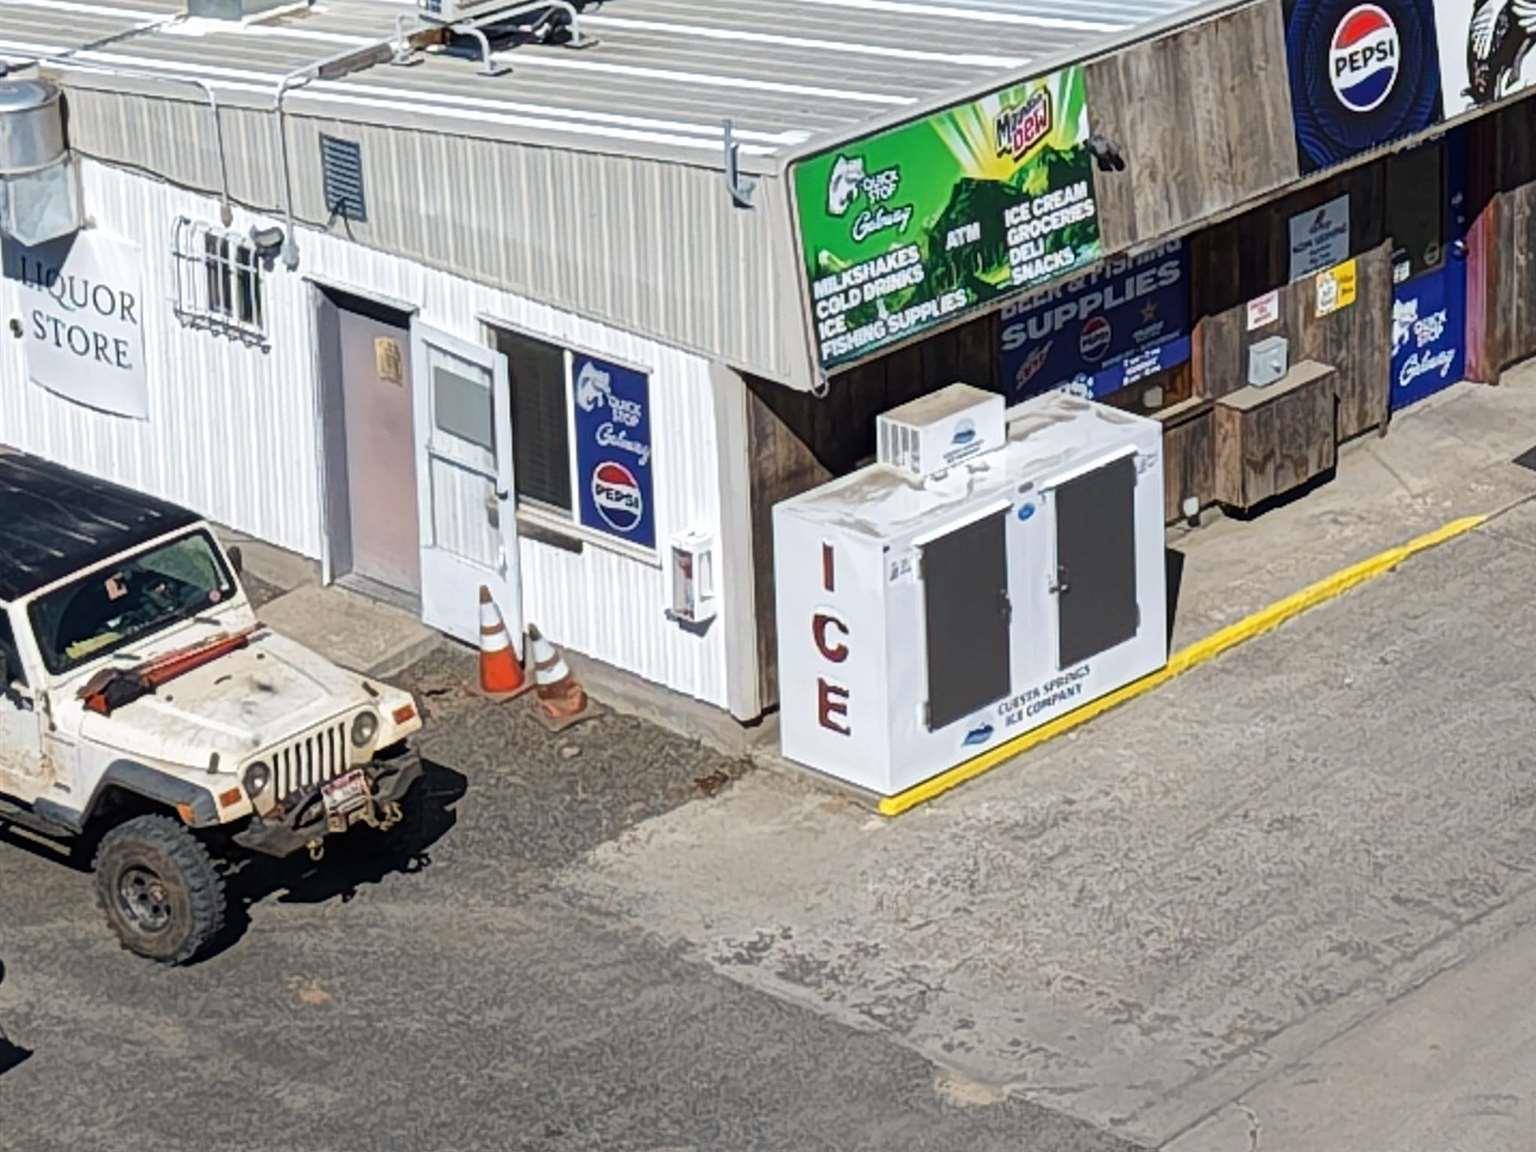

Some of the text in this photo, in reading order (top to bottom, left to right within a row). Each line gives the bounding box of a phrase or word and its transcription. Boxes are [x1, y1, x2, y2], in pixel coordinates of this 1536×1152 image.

[1334, 38, 1395, 78] PEPSI
[1005, 181, 1088, 227] ICE CREAM
[1007, 198, 1094, 246] GROCERIES
[945, 222, 981, 251] ATM
[1009, 237, 1044, 266] DELI
[814, 245, 920, 298] MILKSHAKES
[1012, 246, 1075, 286] SNACKS
[20, 255, 138, 325] LIQUOR
[816, 264, 925, 319] COLD DRINKS
[1001, 260, 1182, 350] SUPPLIES
[32, 309, 133, 370] STORE
[818, 314, 846, 340] ICE
[821, 288, 967, 361] FISHING SUPPLIES
[596, 422, 650, 466] Gateway
[595, 483, 640, 509] PEPSI
[812, 541, 851, 736] ICE
[1026, 683, 1082, 717] COMPANY
